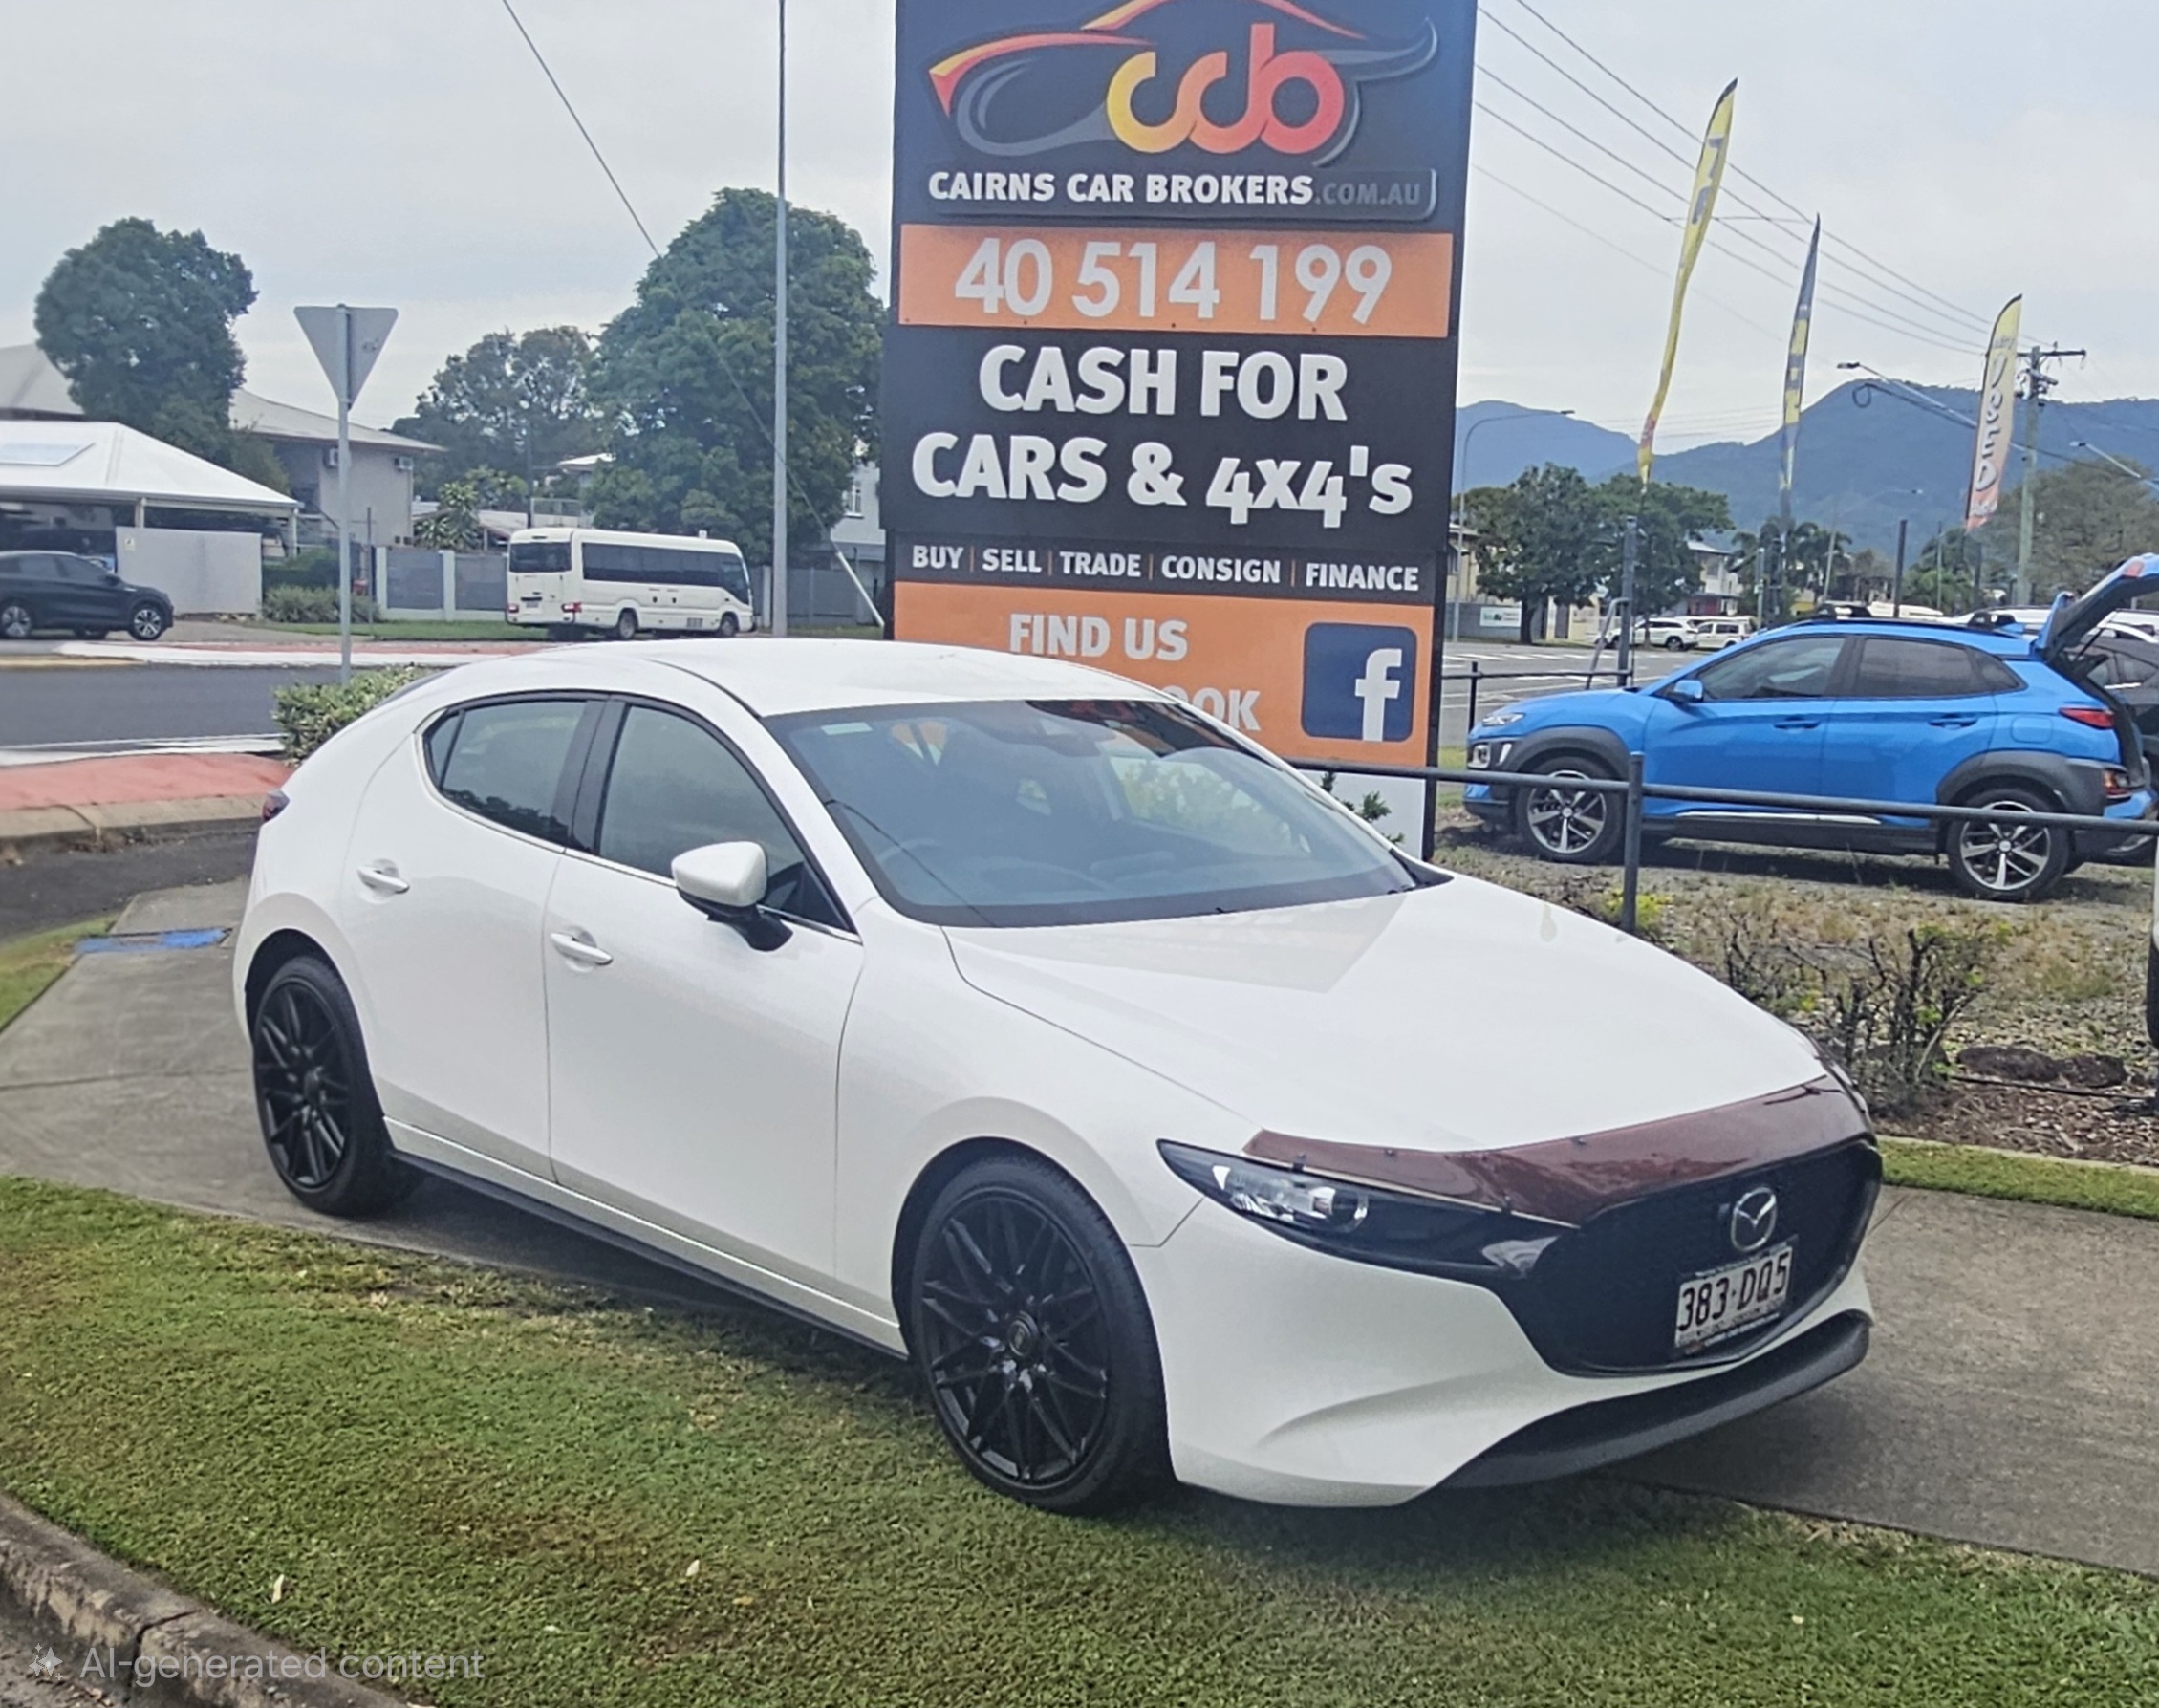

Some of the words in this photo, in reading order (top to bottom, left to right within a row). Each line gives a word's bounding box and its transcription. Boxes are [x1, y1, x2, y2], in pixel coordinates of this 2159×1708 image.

[928, 171, 1055, 202] CAIRNS
[1067, 173, 1134, 202] CAR
[956, 237, 1052, 317] 40
[1071, 241, 1220, 319] 514
[1249, 244, 1393, 325] 199
[979, 344, 1177, 416] CASH
[1200, 350, 1348, 422] FOR
[911, 431, 1108, 504] CARS
[1126, 442, 1187, 507] &
[912, 544, 964, 571] BUY
[982, 548, 1042, 573] SELL
[1060, 551, 1142, 578] TRADE
[1161, 554, 1281, 584] CONSIGN
[1306, 562, 1419, 591] FINANCE
[1009, 613, 1111, 658] FIND
[1124, 617, 1188, 661] US
